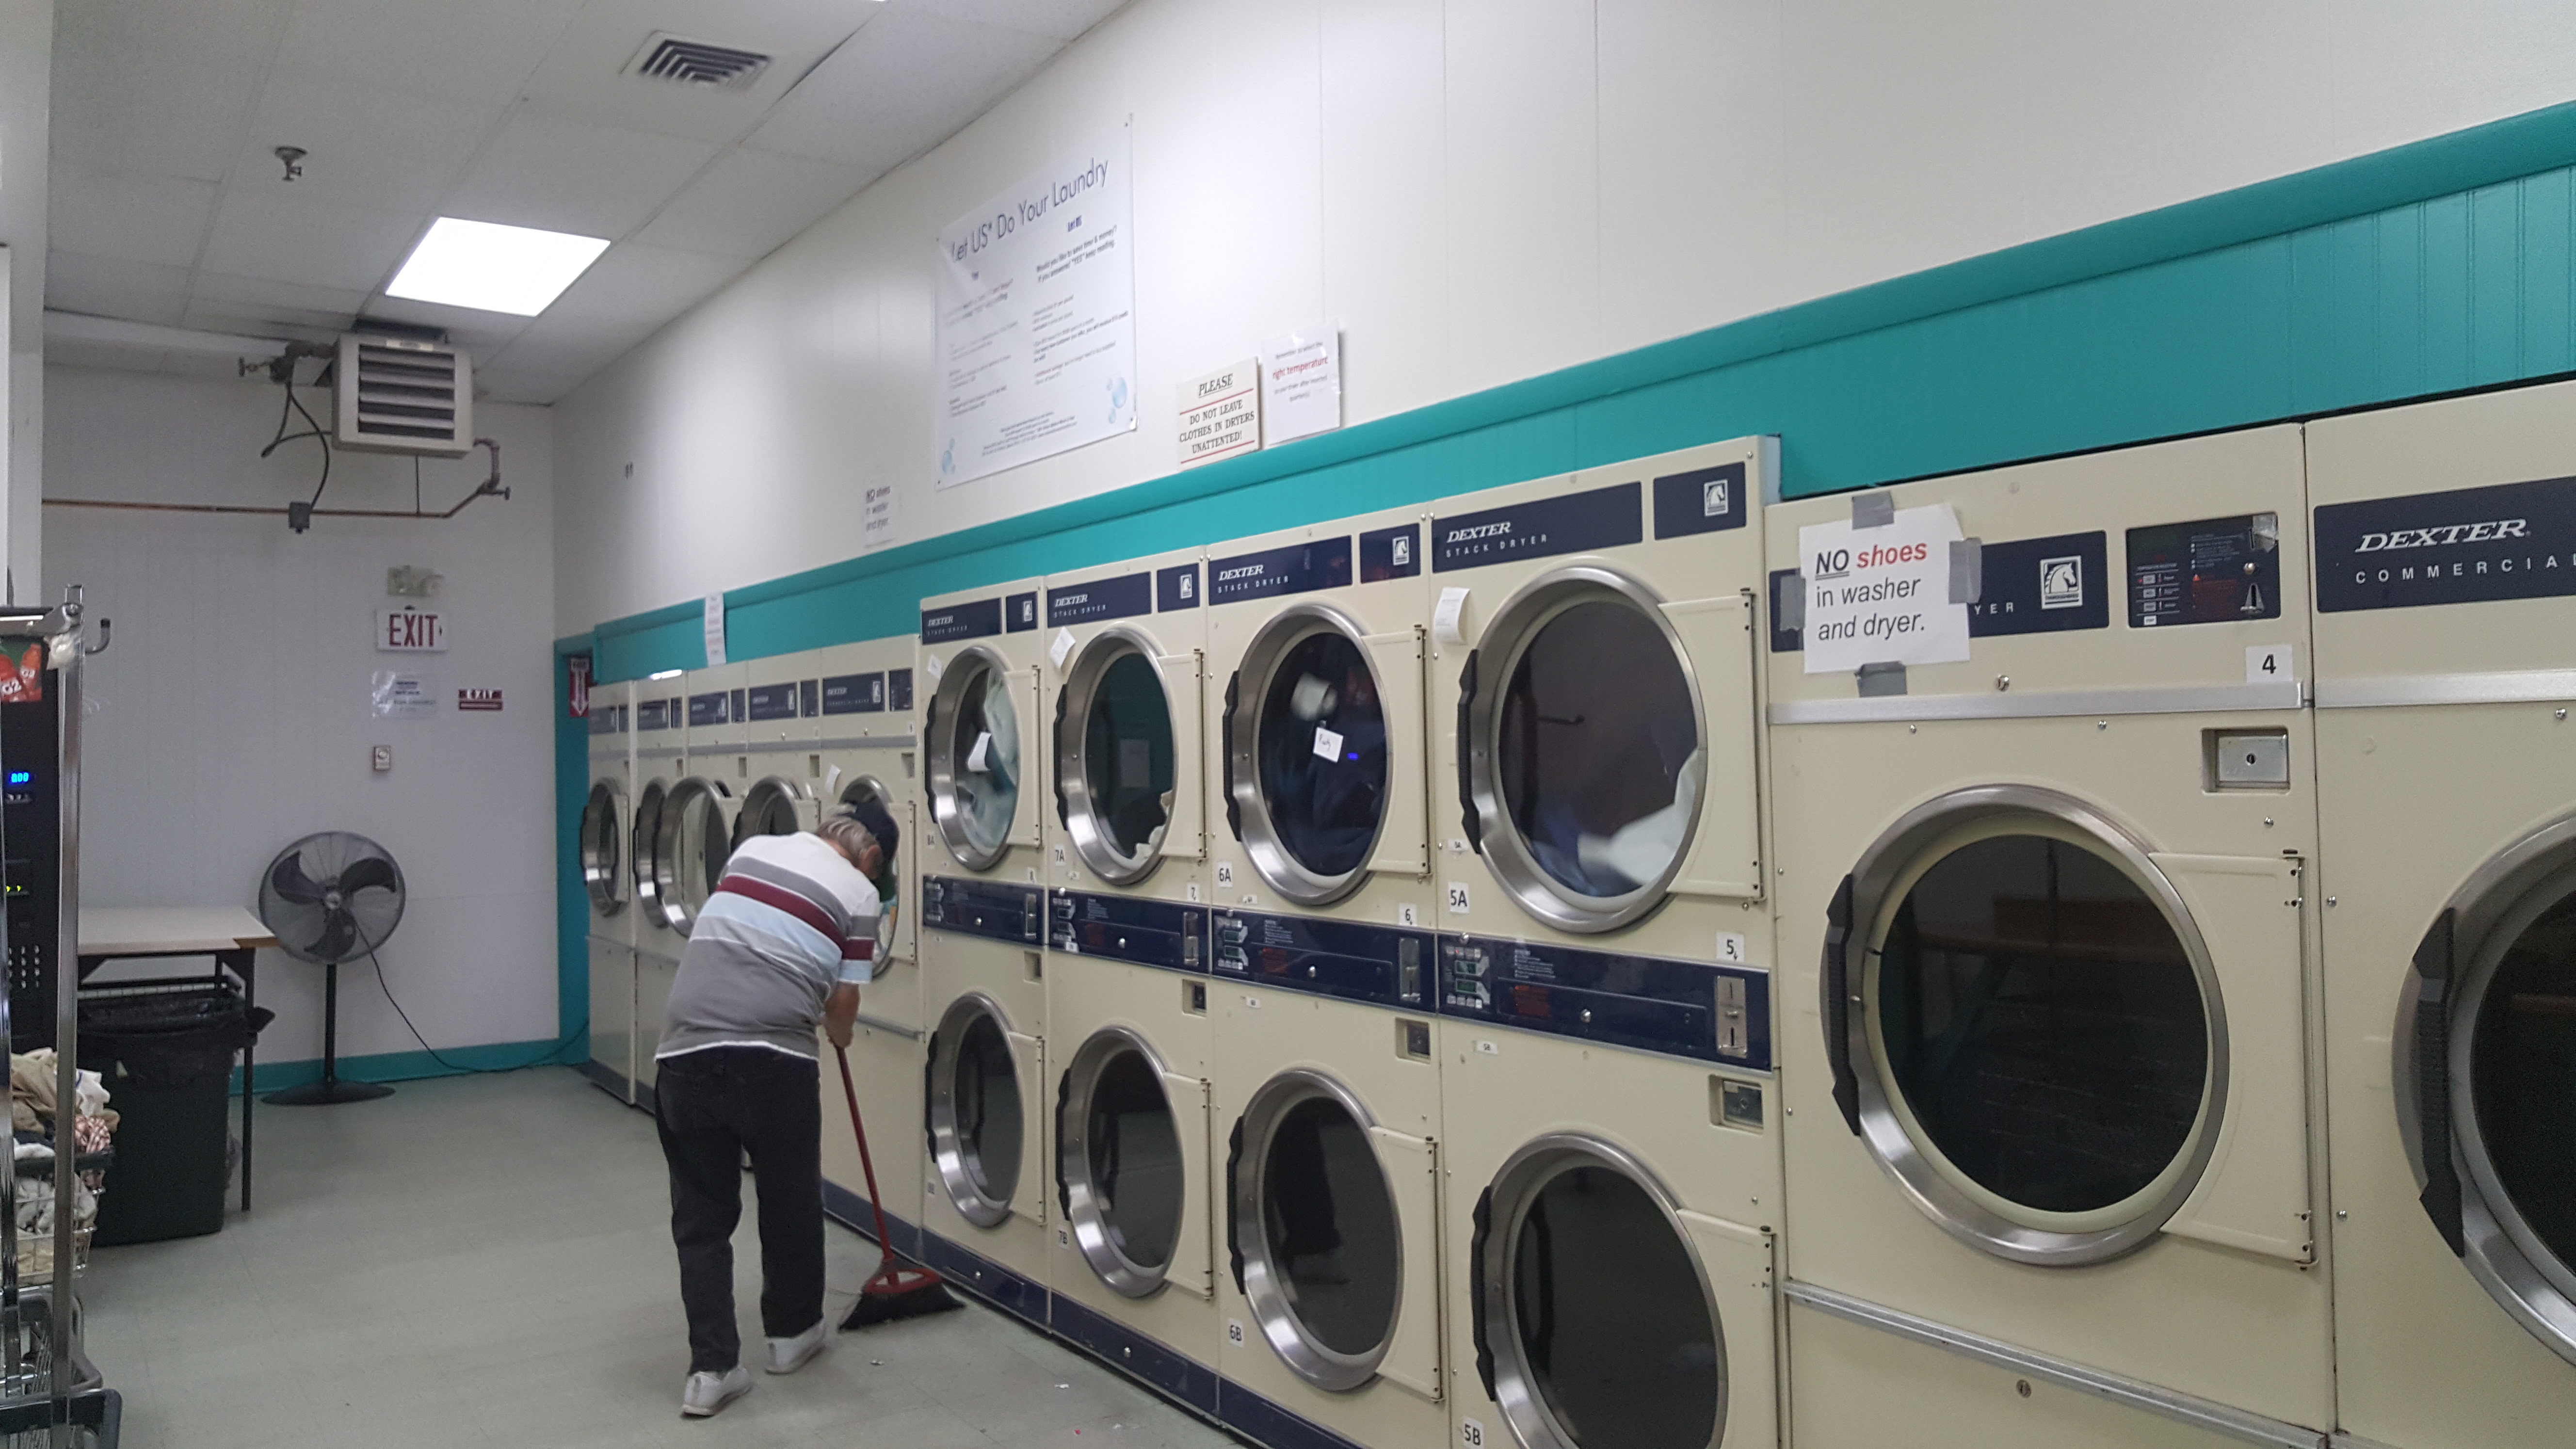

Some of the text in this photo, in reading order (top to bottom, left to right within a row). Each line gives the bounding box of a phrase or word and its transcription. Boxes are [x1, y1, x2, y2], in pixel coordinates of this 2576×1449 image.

[998, 214, 1014, 240] Do
[1019, 200, 1048, 225] Your
[1053, 157, 1108, 207] Laundry
[1287, 356, 1329, 374] temperature
[1199, 373, 1233, 397] PLEASE
[1190, 399, 1243, 425] DO NOT LEAVE
[1179, 411, 1255, 442] CLOTHES IN DRYERS
[1447, 521, 1511, 543] DEXTER
[2355, 518, 2528, 553] DEXTER
[1446, 533, 1547, 558] STACK DRYER
[1815, 542, 1928, 575] NO shoes
[1218, 564, 1264, 581] DEXTER
[1218, 575, 1288, 594] STACK DRYER
[1817, 577, 1921, 608] in washer
[1055, 594, 1088, 607] DEXTER
[389, 613, 438, 647] EXIT
[928, 615, 954, 627] DEXTER
[1818, 612, 1925, 641] and dryer.
[2262, 654, 2277, 675] 4
[1055, 849, 1065, 862] 7A
[1219, 868, 1232, 882] 6A
[1450, 889, 1468, 907] 5A
[1405, 908, 1411, 921] 6
[1726, 939, 1735, 955] 5
[1230, 1324, 1242, 1342] 6B
[1464, 1424, 1481, 1446] 5B
